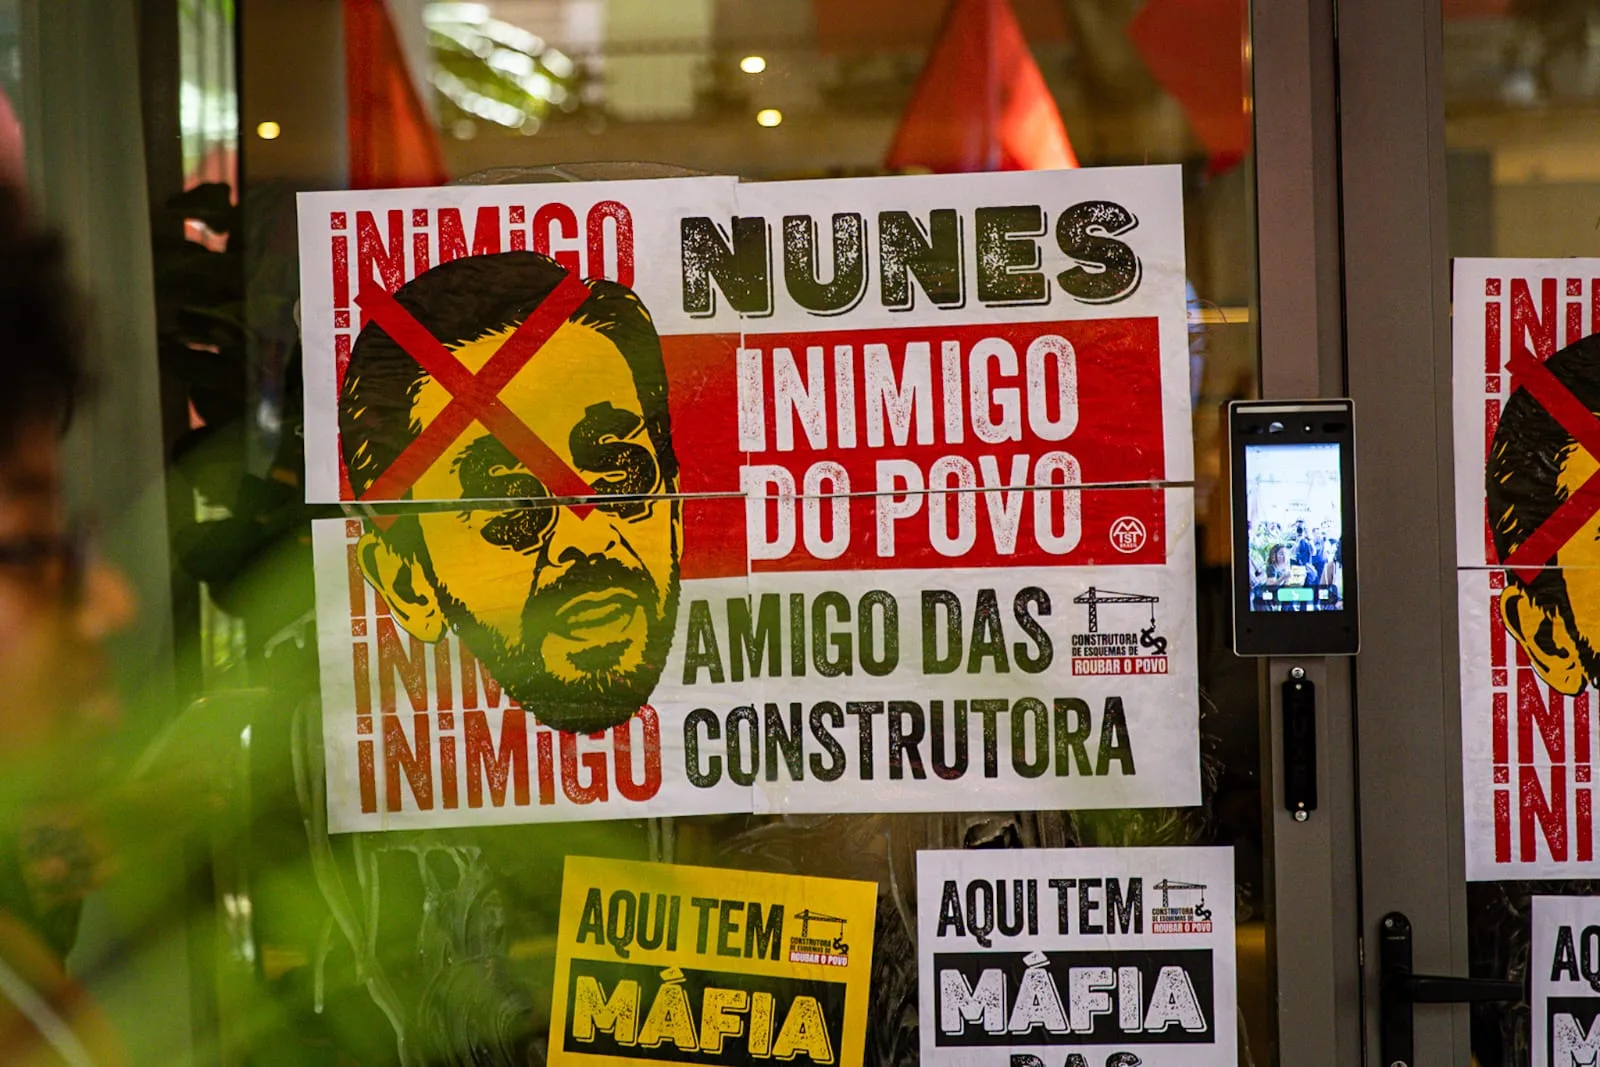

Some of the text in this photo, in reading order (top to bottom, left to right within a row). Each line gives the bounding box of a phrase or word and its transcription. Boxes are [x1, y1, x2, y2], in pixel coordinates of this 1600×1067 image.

[680, 200, 1141, 318] NUNES
[736, 335, 1079, 453] INIMIGO
[739, 451, 1082, 561] DO POVO
[682, 586, 1053, 685] AMIGO DAS
[1072, 633, 1138, 646] CONSTRUTORA
[1072, 646, 1138, 657] DE ESQUEMAS DE
[1075, 658, 1167, 674] ROUBAR O POVO
[683, 696, 1136, 788] CONSTRUTORA
[576, 887, 784, 961] AQUI TEM
[937, 877, 1143, 949] AQUI TEM
[572, 967, 834, 1064] MÁFIA
[940, 951, 1207, 1035] MÁFIA
